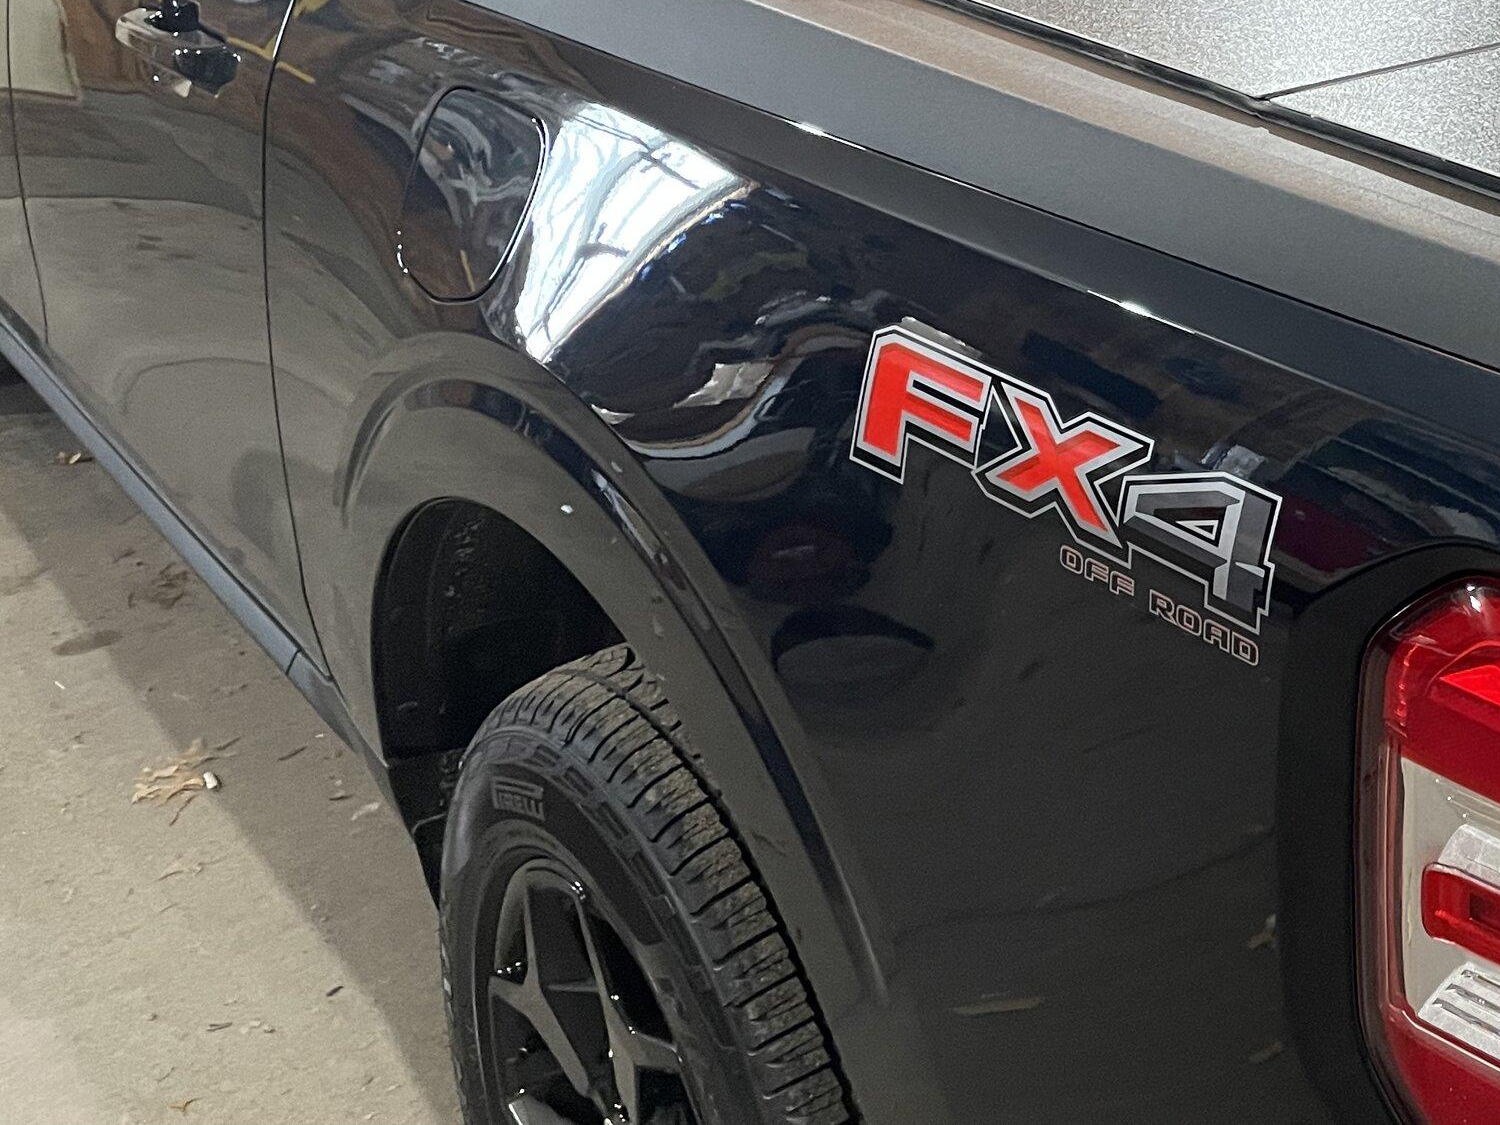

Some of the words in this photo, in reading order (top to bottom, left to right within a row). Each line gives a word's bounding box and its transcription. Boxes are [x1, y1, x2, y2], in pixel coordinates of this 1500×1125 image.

[849, 325, 1282, 634] FX4
[1060, 546, 1135, 597] OFF
[1149, 590, 1260, 666] ROAD
